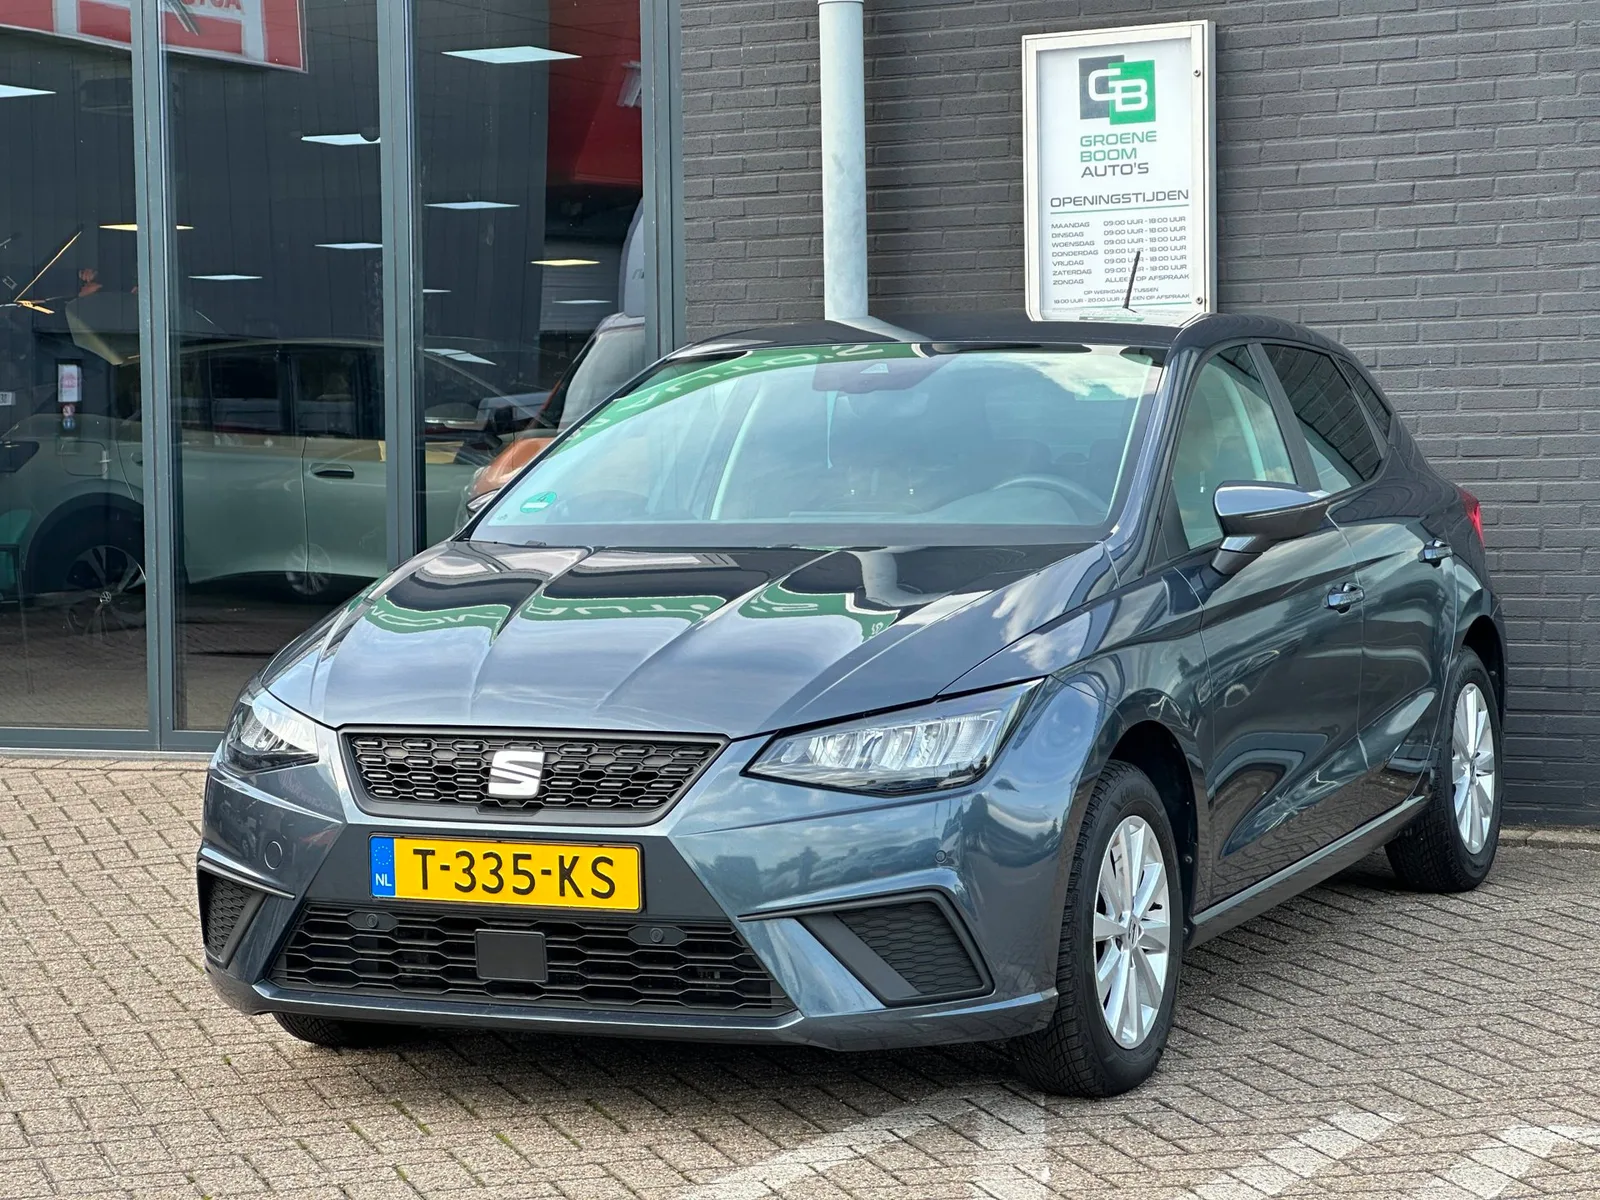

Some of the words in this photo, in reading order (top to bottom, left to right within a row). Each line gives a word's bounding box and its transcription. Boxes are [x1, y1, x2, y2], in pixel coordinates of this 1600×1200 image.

[1080, 130, 1157, 147] GROENE
[1080, 147, 1137, 163] BOOM
[1081, 162, 1149, 179] AUTO'S
[1050, 189, 1189, 208] OPENINGSTIJDEN
[1051, 221, 1090, 229] MAANDAG
[1051, 231, 1084, 239] DINSDAG
[1051, 240, 1095, 248] WOENSDAG
[1051, 249, 1099, 258] DONDERDAG
[1170, 244, 1187, 252] UUR
[1052, 259, 1084, 267] VRIJDAG
[1052, 268, 1092, 276] ZATERDAG
[1170, 263, 1188, 271] UUR
[1053, 278, 1084, 286] ZONDAG
[1148, 273, 1190, 281] AFSPRAAK
[375, 875, 392, 888] NL
[412, 848, 617, 900] T-335-KS
